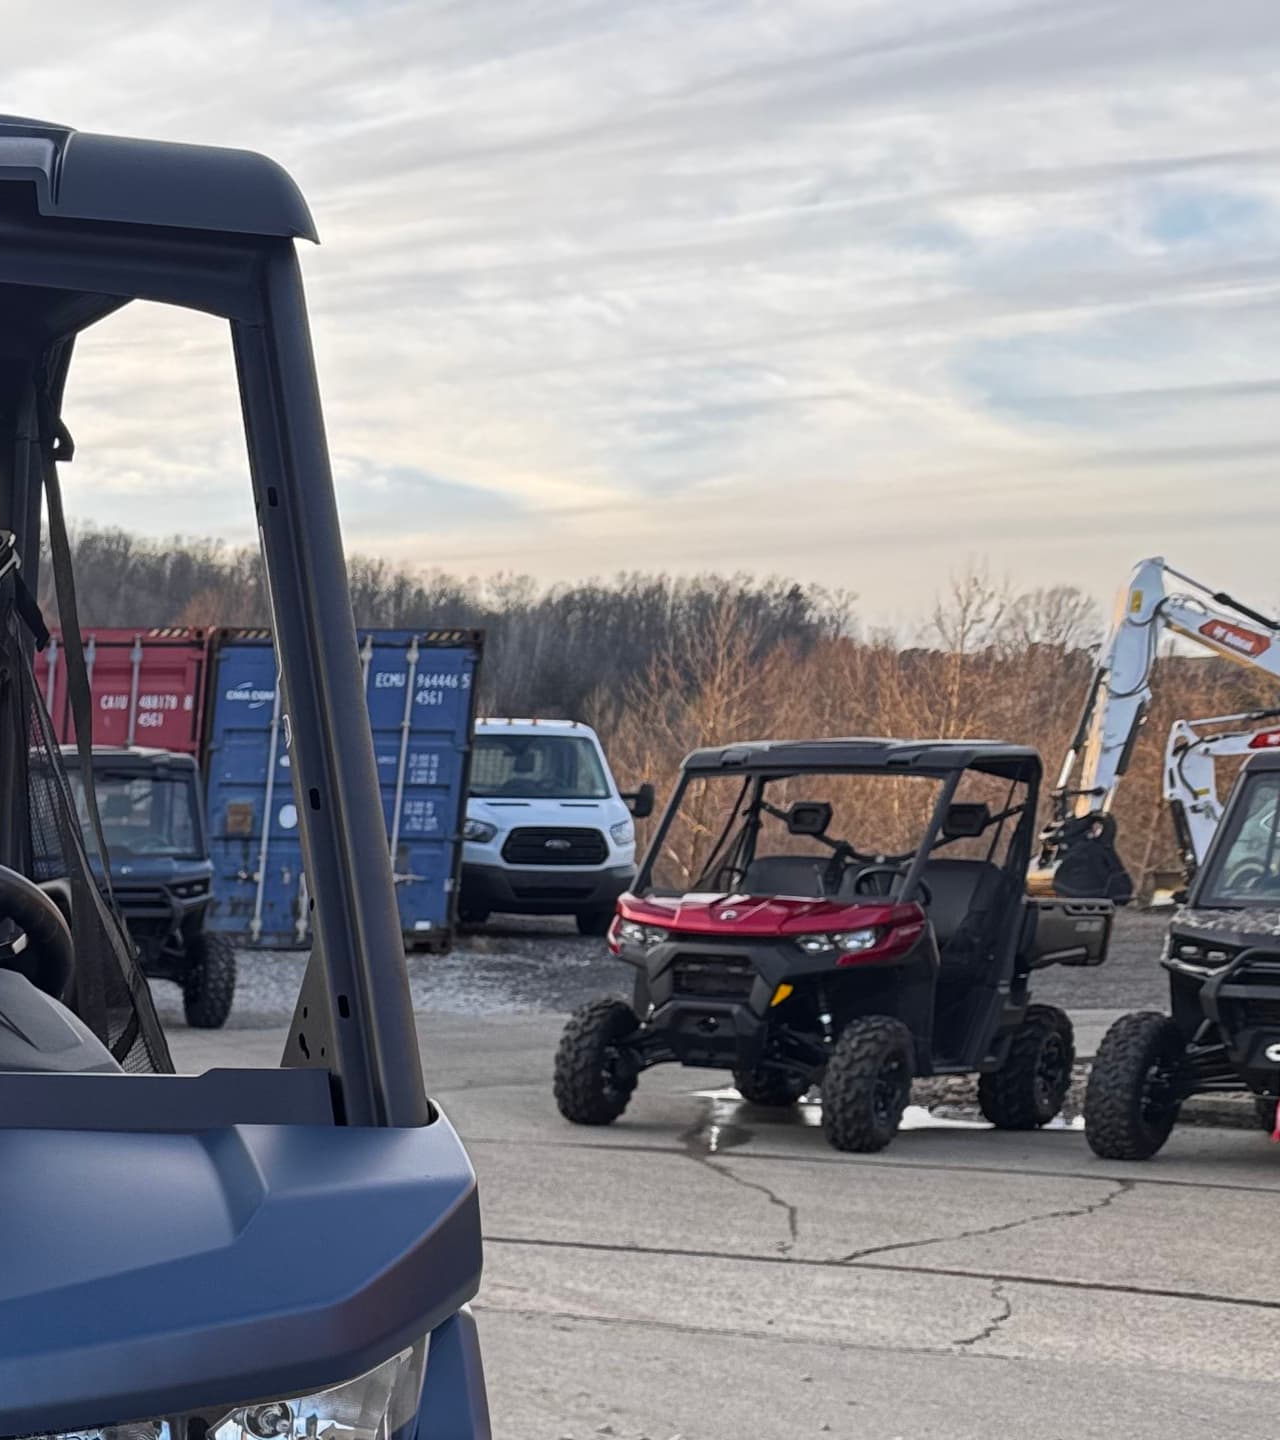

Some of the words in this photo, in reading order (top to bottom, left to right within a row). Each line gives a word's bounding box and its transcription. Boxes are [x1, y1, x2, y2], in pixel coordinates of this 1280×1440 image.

[375, 672, 406, 688] ECMU
[416, 672, 458, 689] 964446
[461, 672, 472, 689] 5
